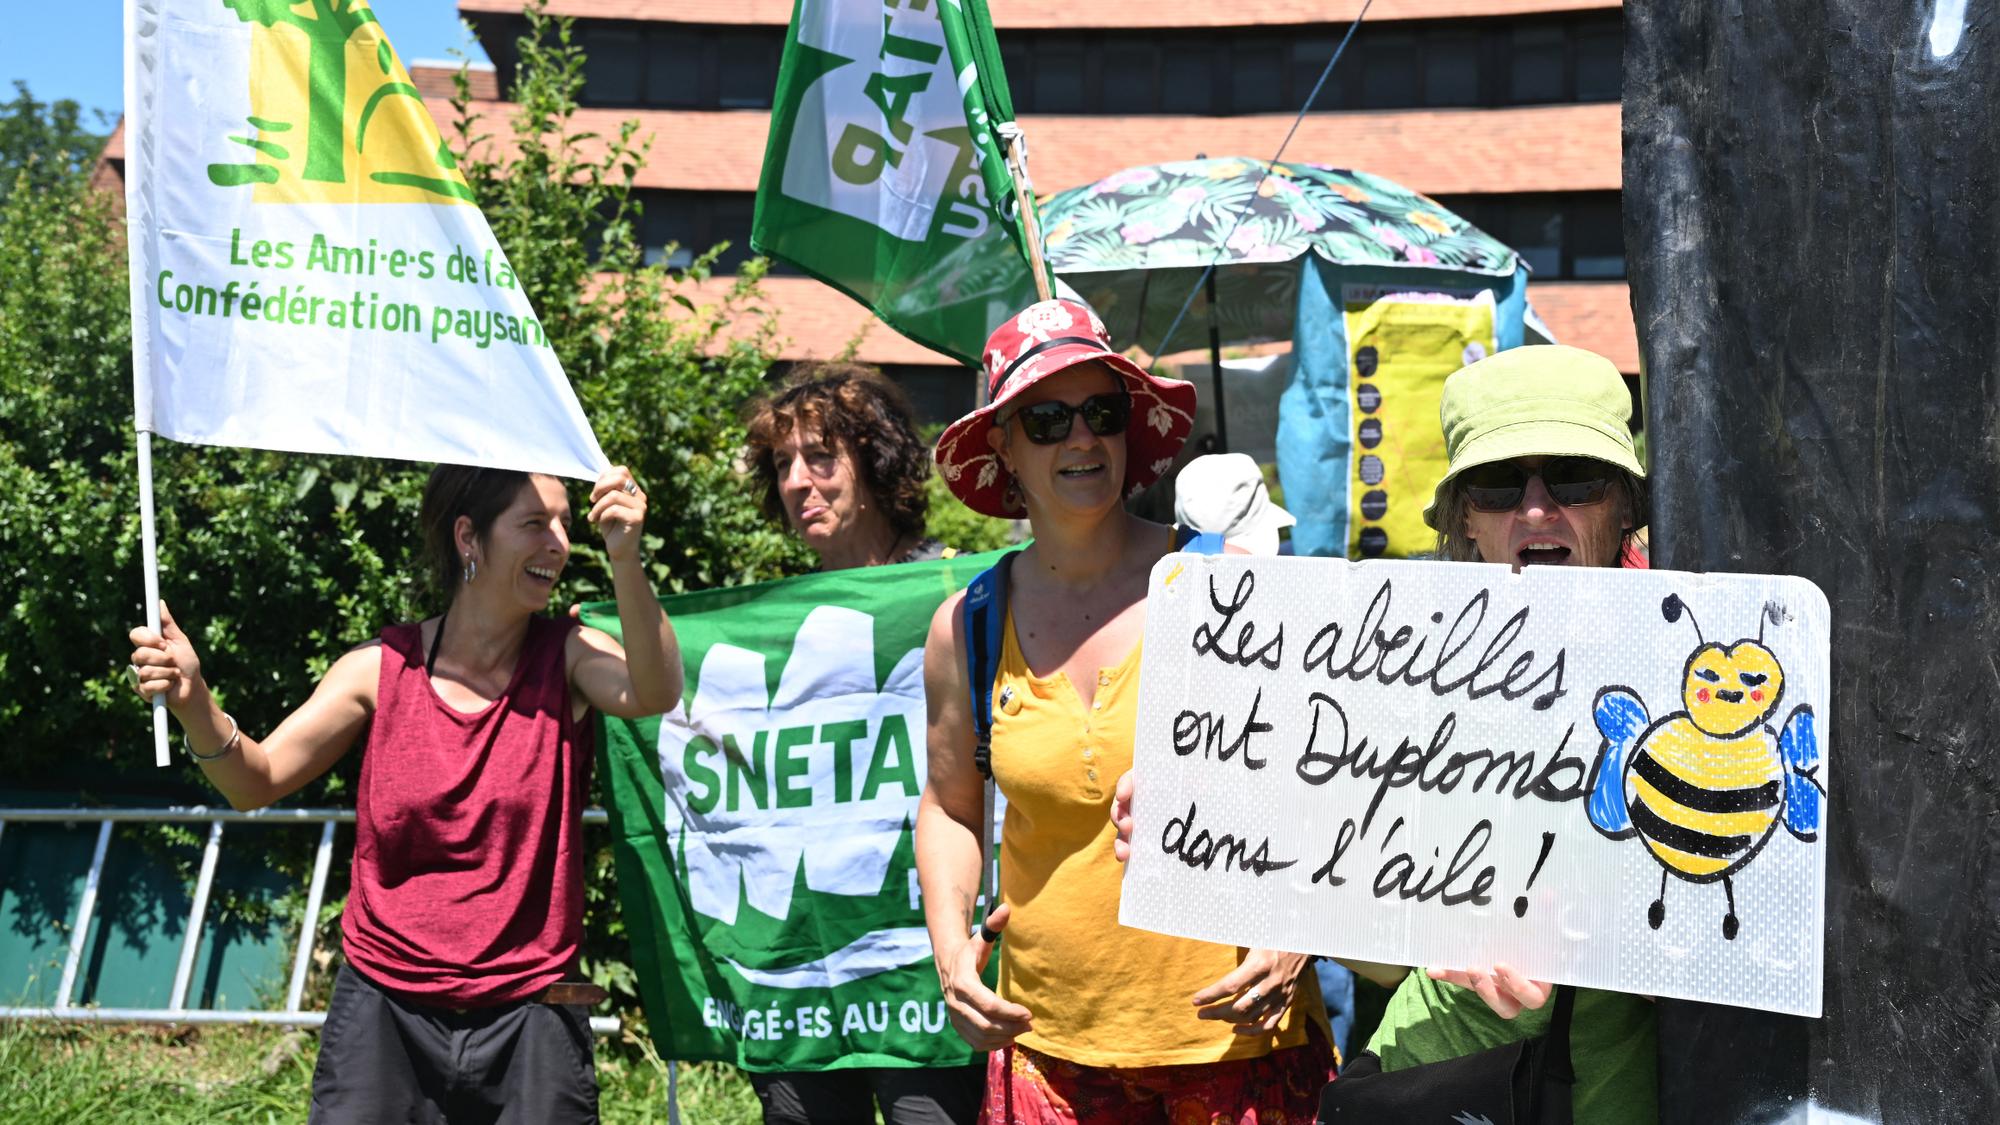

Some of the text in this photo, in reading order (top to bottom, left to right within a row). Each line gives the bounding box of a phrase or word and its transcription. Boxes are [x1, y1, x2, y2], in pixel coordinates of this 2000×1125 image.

[230, 228, 294, 270] Les
[446, 244, 478, 285] de
[484, 249, 517, 290] la
[157, 270, 422, 333] Confédération
[1192, 569, 1569, 711] Les abeilles
[1172, 687, 1595, 841] ont Duplomb
[1161, 801, 1297, 877] dans
[841, 1000, 890, 1037] AU
[898, 999, 951, 1034] QU
